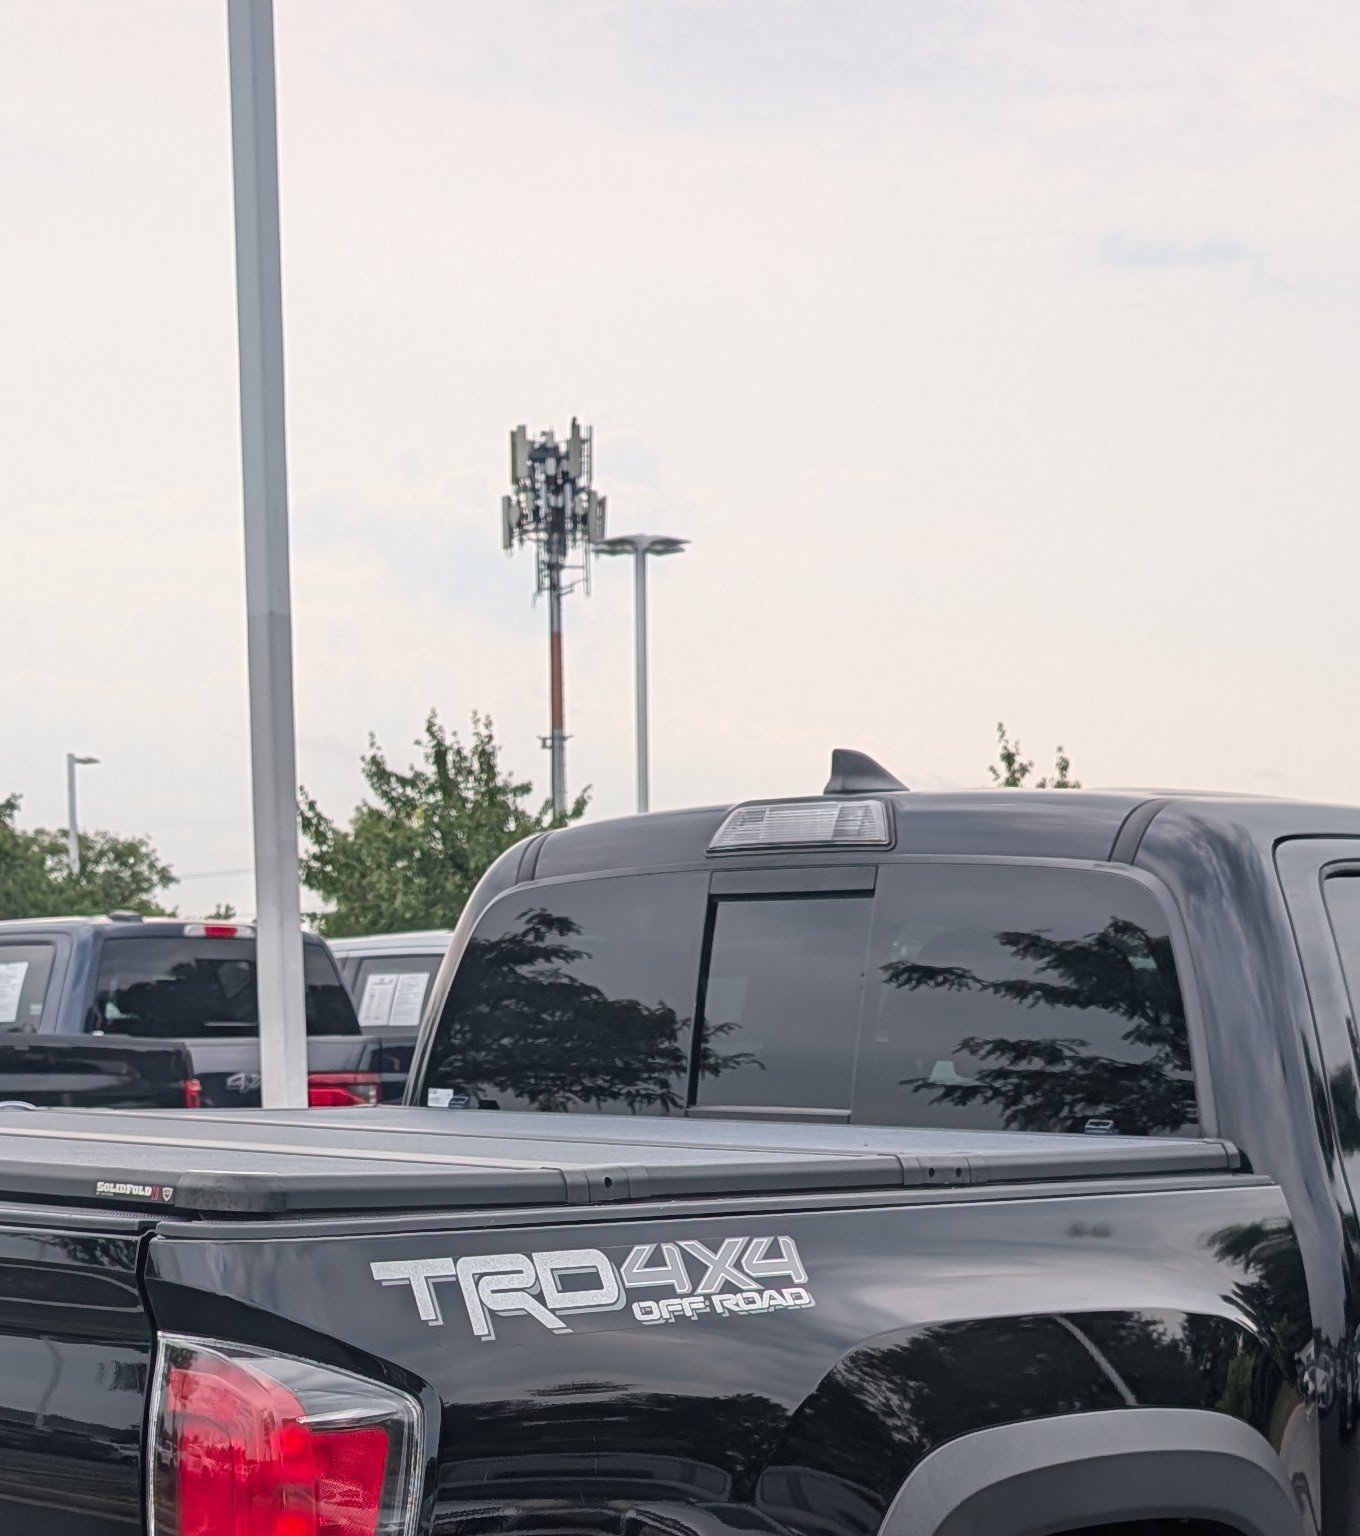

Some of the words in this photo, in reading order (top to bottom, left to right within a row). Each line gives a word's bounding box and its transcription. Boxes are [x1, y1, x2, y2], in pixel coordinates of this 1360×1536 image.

[369, 1248, 627, 1342] TRD
[631, 1295, 711, 1325] OFF
[712, 1287, 817, 1319] ROAD
